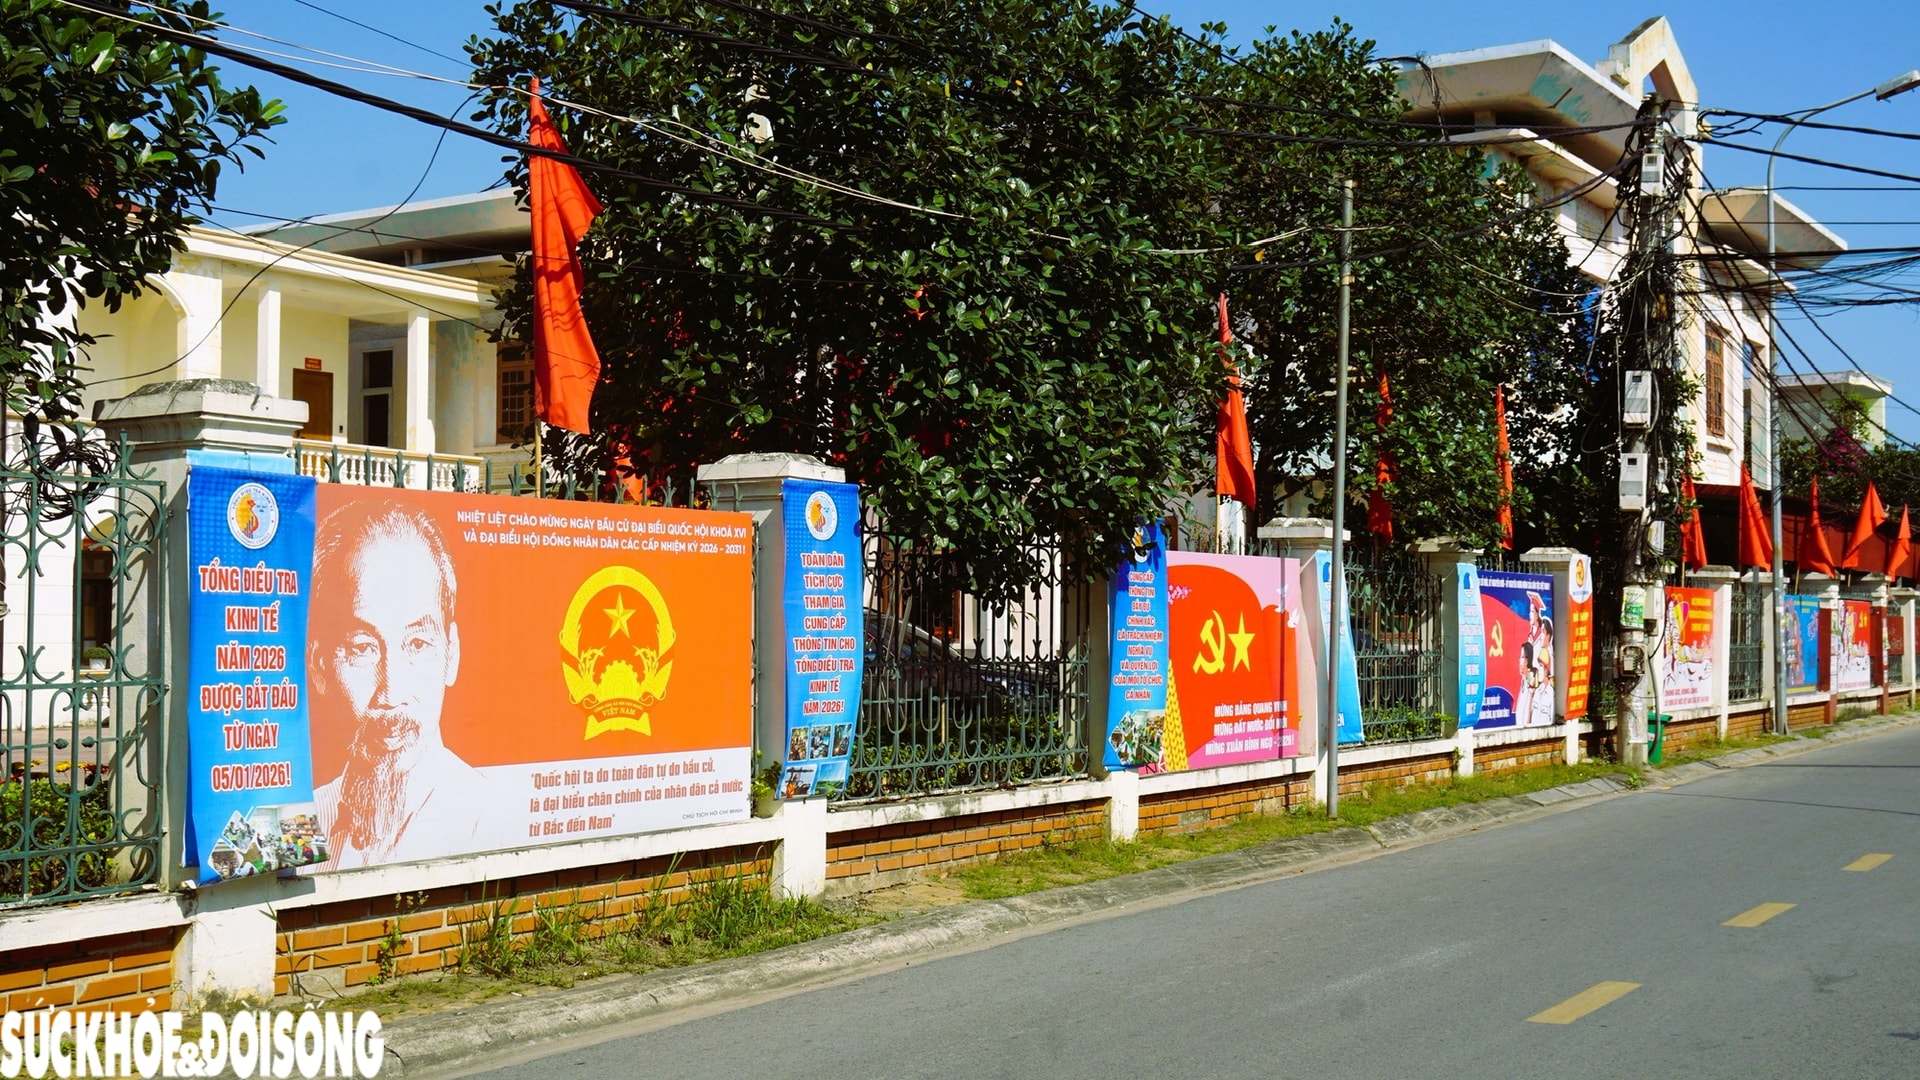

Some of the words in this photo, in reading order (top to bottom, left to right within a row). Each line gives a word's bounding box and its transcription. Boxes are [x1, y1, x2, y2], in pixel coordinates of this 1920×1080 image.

[457, 509, 485, 526] NHIỆT
[488, 511, 507, 527] LIỆT
[508, 512, 537, 526] CHÀO
[539, 514, 568, 528] MỪNG
[570, 516, 594, 529] NGÀY
[631, 521, 646, 536] ĐẠI
[694, 524, 709, 539] HỘI
[710, 523, 732, 538] KHOÁ
[734, 527, 747, 538] XVI
[464, 528, 478, 542] VÀ
[480, 531, 497, 546] ĐẠI
[500, 528, 521, 544] BIỂU
[523, 532, 540, 548] HỘI
[573, 534, 598, 548] NHÂN
[600, 536, 619, 549] DÂN
[620, 537, 640, 550] CÁC
[641, 537, 659, 551] CẤP
[660, 540, 686, 554] NHIỆM
[700, 543, 718, 554] 2026
[801, 551, 825, 567] TOÀN
[826, 551, 845, 567] DÂN
[199, 558, 240, 592] TỔNG
[243, 560, 274, 594] ĐIỀU
[276, 569, 298, 594] TRA
[804, 595, 830, 610] THAM
[830, 595, 845, 609] GIA
[226, 606, 259, 632] KINH
[261, 601, 280, 632] TẾ
[804, 615, 828, 630] CUNG
[830, 612, 846, 629] CẤP
[216, 641, 250, 671] NĂM
[252, 646, 285, 671] 2026
[793, 635, 821, 651] THÔNG
[823, 637, 837, 650] TIN
[839, 637, 856, 650] CHO
[201, 683, 242, 715] ĐƯỢC
[245, 677, 268, 709] BẮT
[271, 677, 297, 709] ĐẦU
[809, 678, 828, 694] KINH
[829, 675, 841, 692] TẾ
[803, 698, 819, 716] NĂM
[820, 700, 844, 715] 2026!
[224, 719, 243, 750] TỪ
[246, 719, 279, 749] NGÀY
[211, 762, 292, 792] 05/01/2026!
[564, 769, 580, 788] hội
[584, 770, 593, 784] ta
[597, 768, 609, 782] do
[612, 766, 633, 781] toàn
[637, 764, 654, 779] dân
[656, 763, 667, 780] tự
[669, 762, 680, 776] do
[530, 798, 540, 812] là
[543, 796, 560, 815] đại
[562, 790, 585, 810] biểu
[588, 791, 612, 807] chân
[615, 788, 642, 804] chính
[644, 785, 662, 801] của
[664, 784, 687, 799] nhân
[690, 782, 706, 797] dân
[709, 779, 719, 795] cả
[722, 779, 743, 793] nước
[529, 822, 541, 837] từ
[543, 818, 564, 836] Bắc
[566, 815, 586, 833] đến
